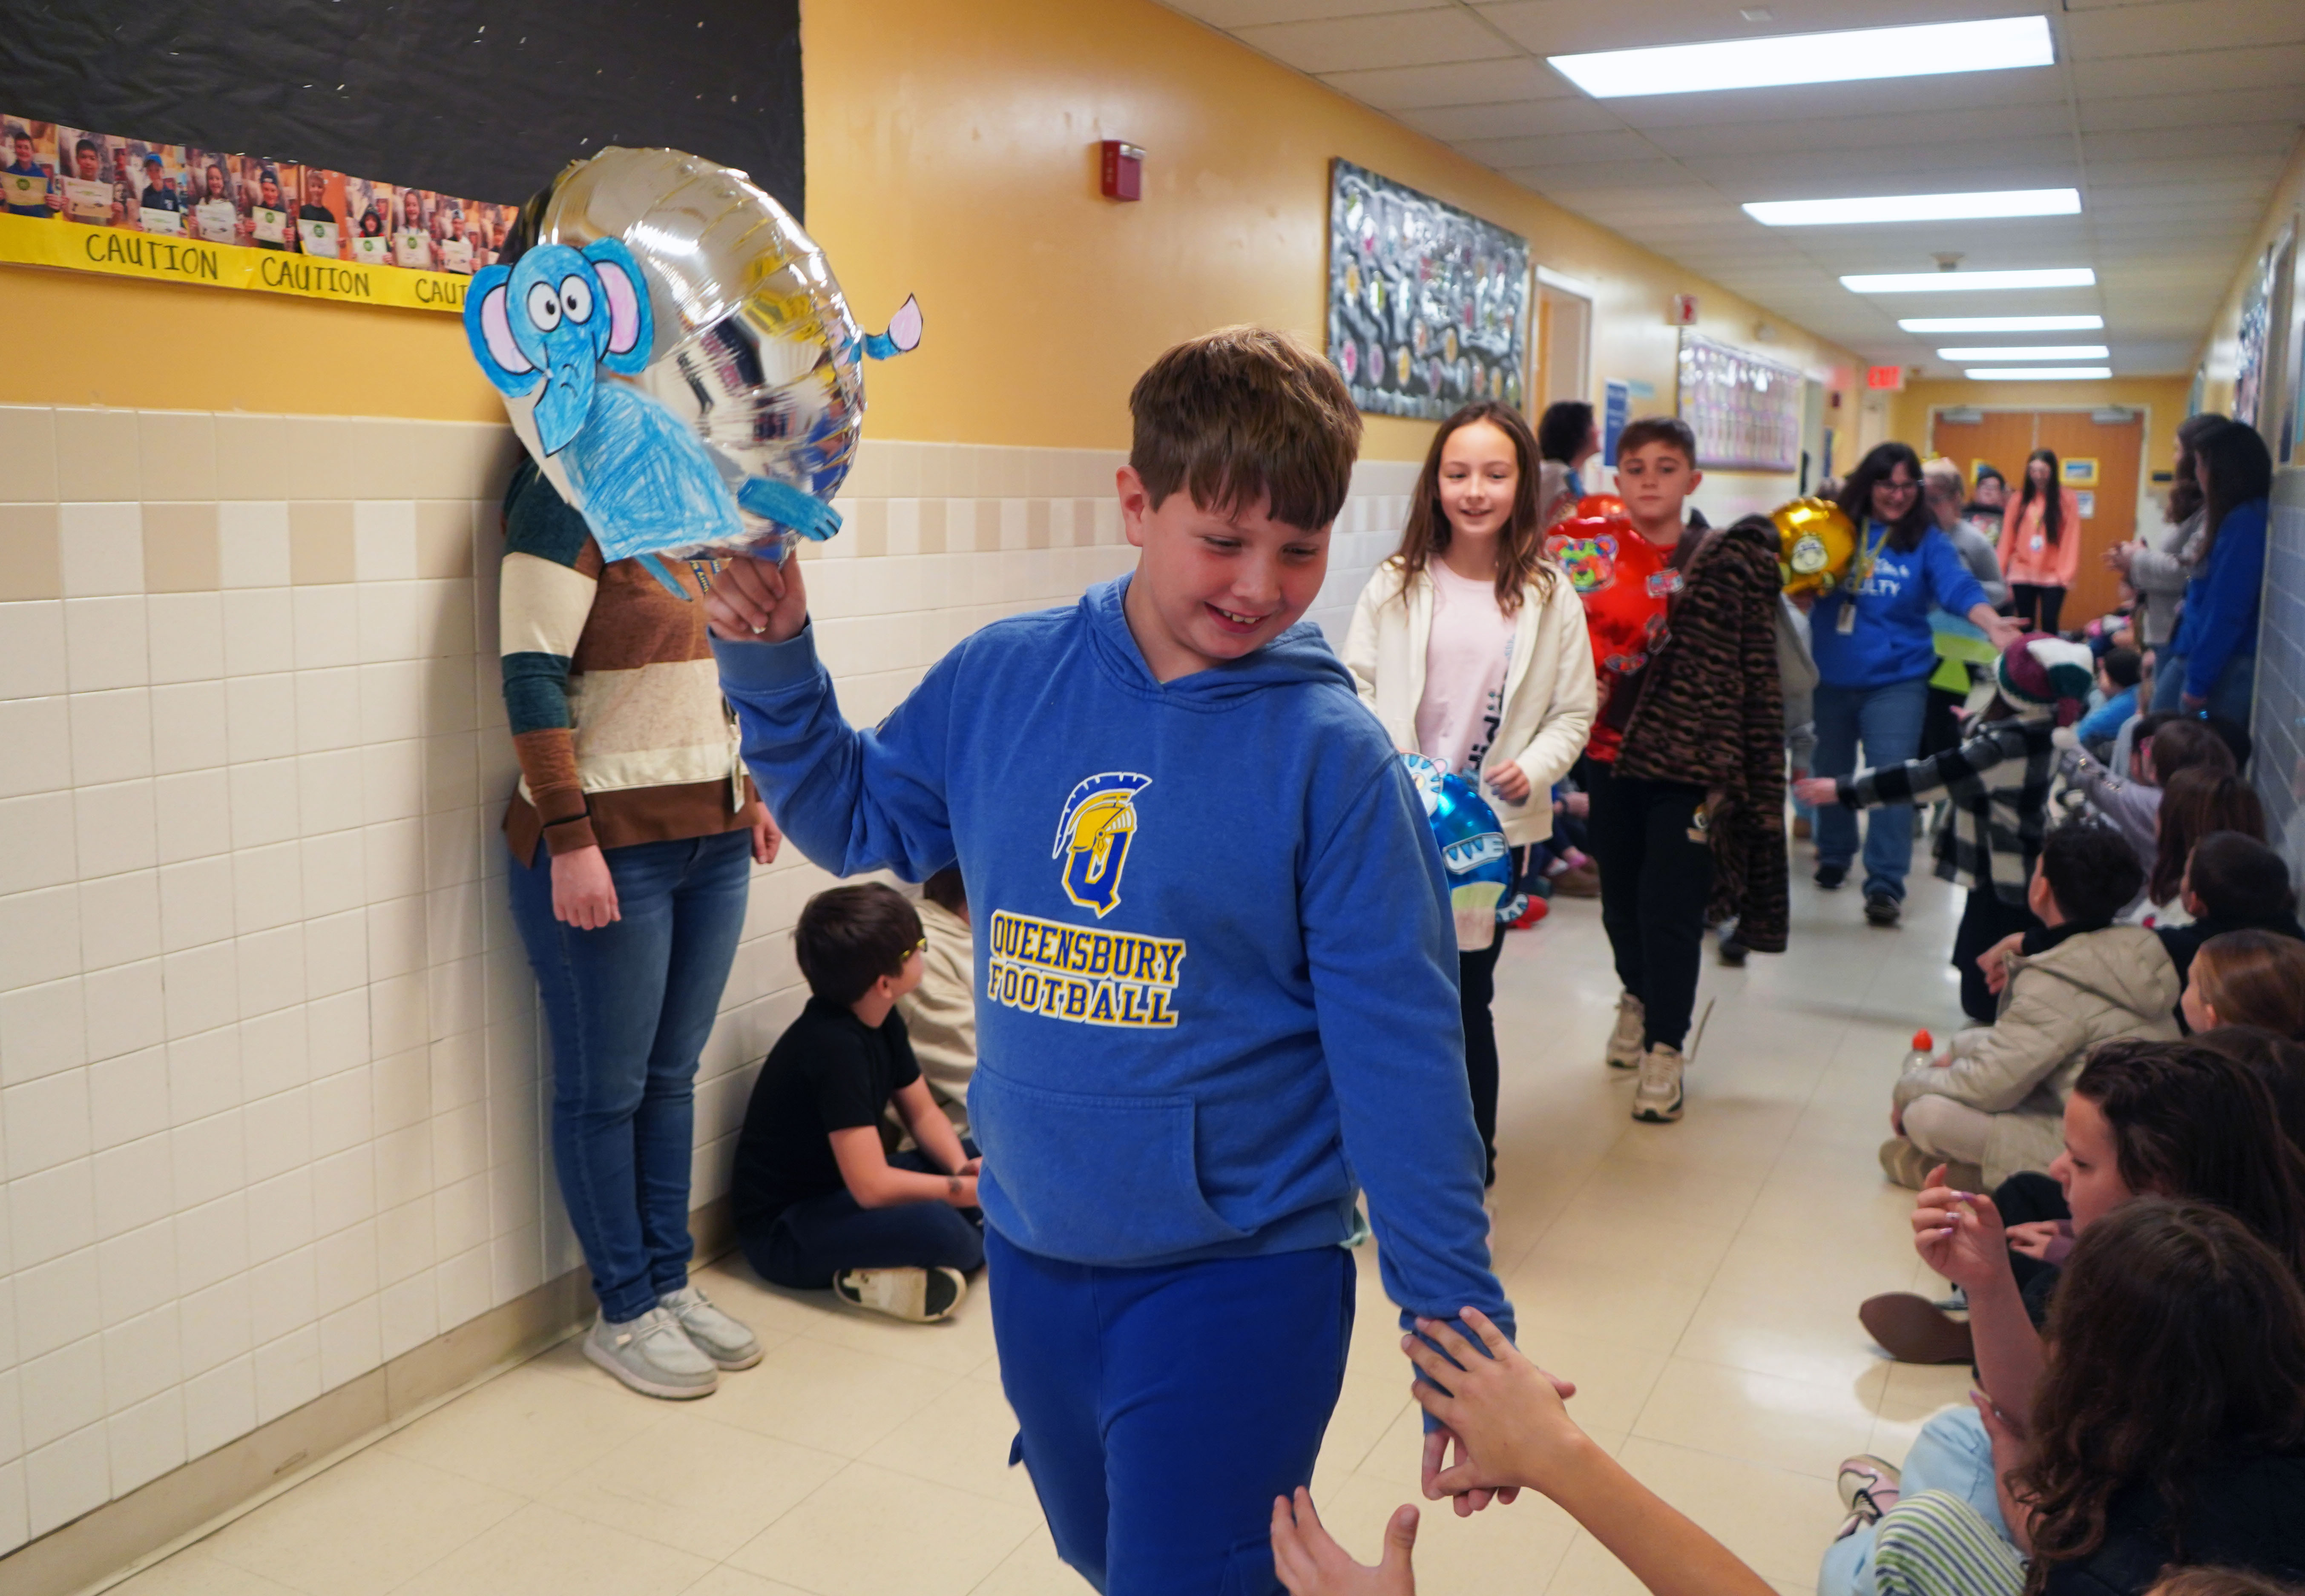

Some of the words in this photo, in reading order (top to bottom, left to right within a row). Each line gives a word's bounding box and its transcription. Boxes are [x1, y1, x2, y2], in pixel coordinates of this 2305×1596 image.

[86, 234, 218, 280] CAUTION
[261, 257, 370, 297] CAUTION
[415, 278, 468, 305] CAUT
[992, 911, 1184, 985] QUEENSBURY
[988, 960, 1176, 1027] FOOTBALL
